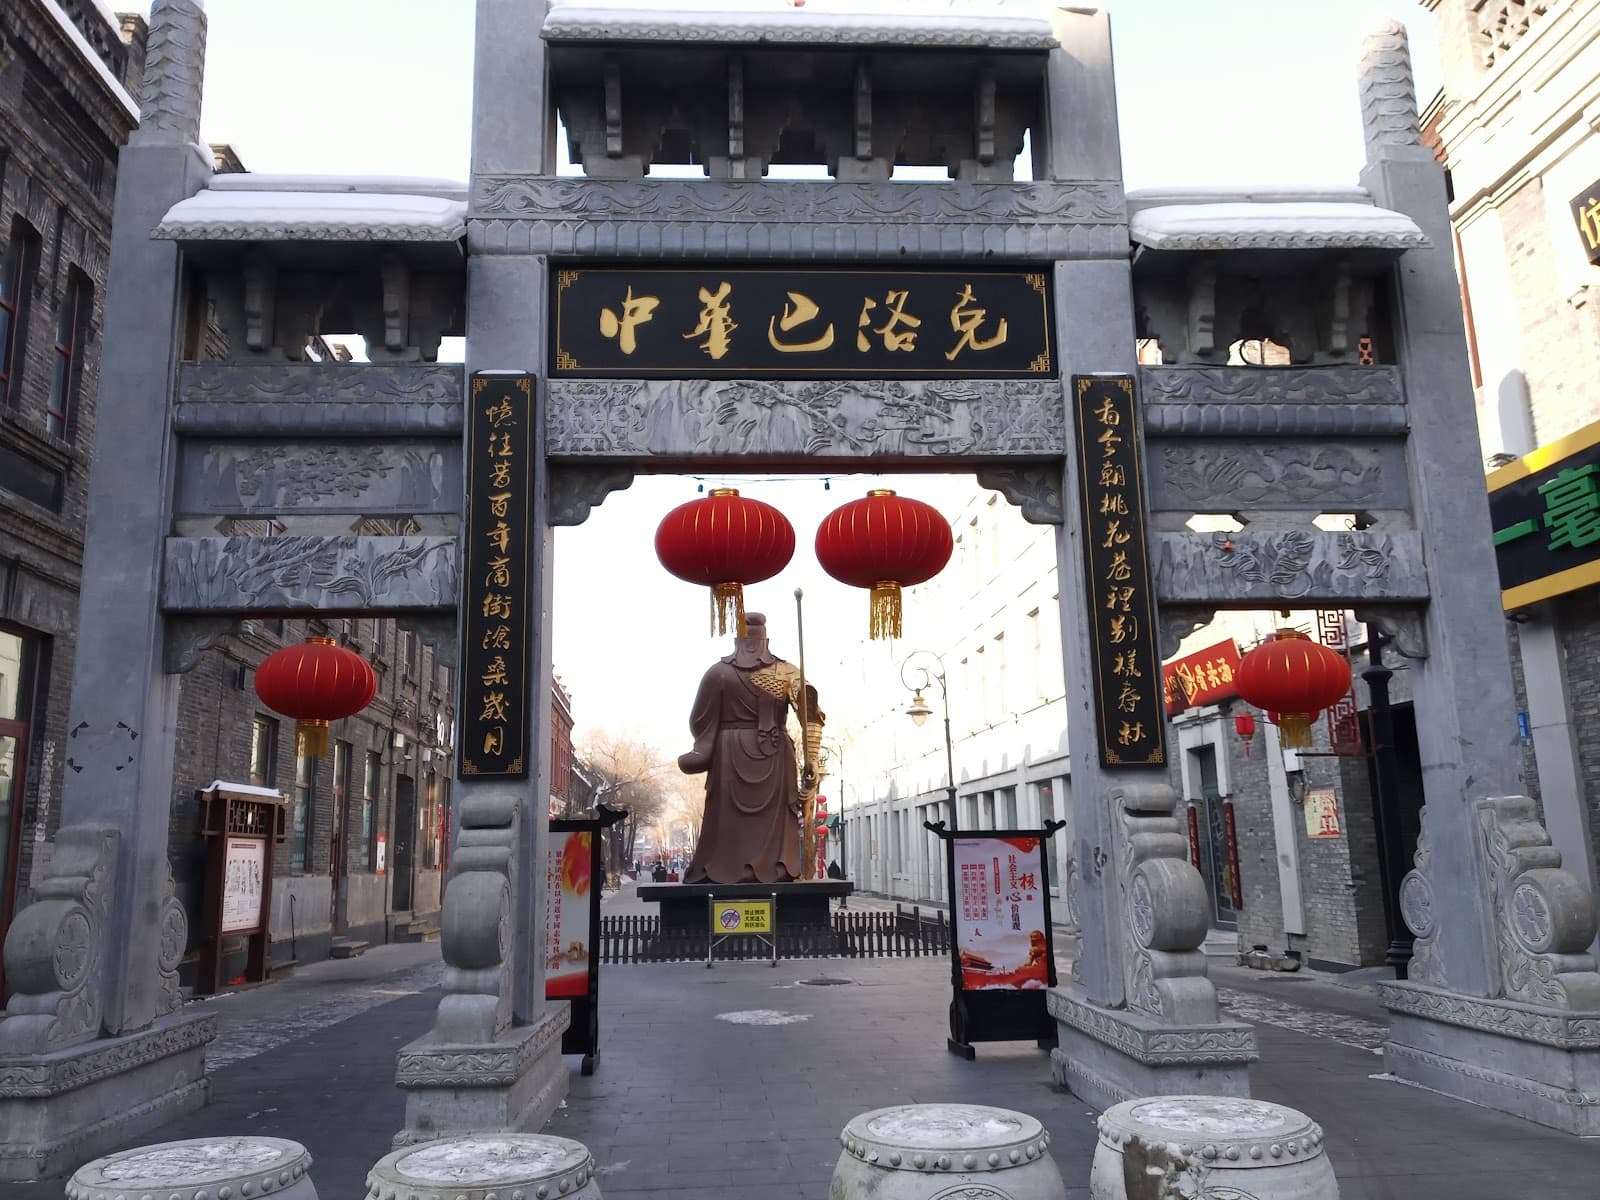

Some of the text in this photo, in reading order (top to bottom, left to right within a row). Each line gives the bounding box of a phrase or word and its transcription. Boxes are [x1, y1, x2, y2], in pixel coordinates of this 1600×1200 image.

[600, 281, 1008, 360] 中華巴洛克
